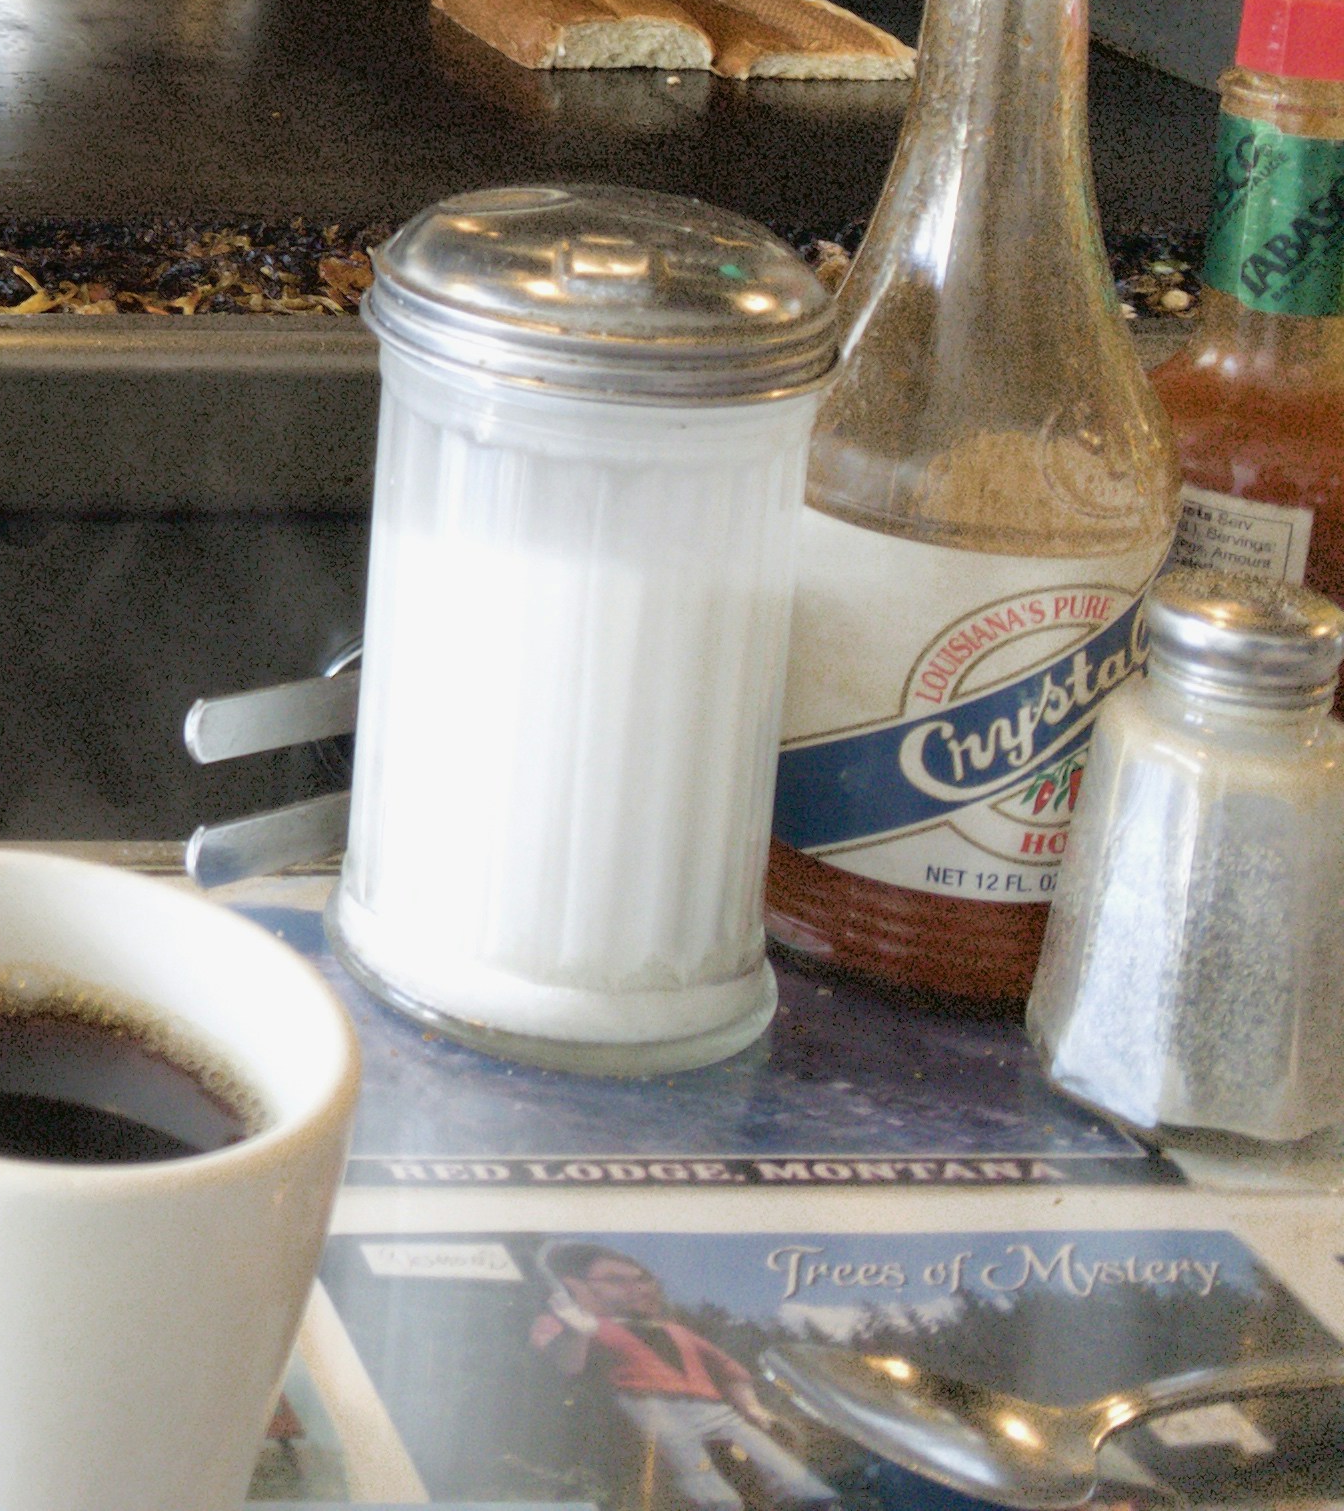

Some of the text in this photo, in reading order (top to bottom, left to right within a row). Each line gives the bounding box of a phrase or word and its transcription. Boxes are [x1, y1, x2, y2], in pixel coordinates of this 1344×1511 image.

[1212, 546, 1272, 569] Amount
[915, 595, 1116, 704] LOUISIANA'S PURE
[898, 600, 1150, 802] Crystal
[1020, 831, 1069, 855] HO
[925, 864, 967, 887] NET
[976, 872, 999, 891] 12
[1005, 874, 1032, 892] FL.
[388, 1159, 1064, 1184] RED LODGE, MONTANA
[767, 1242, 1221, 1299] Trees of Mystery
